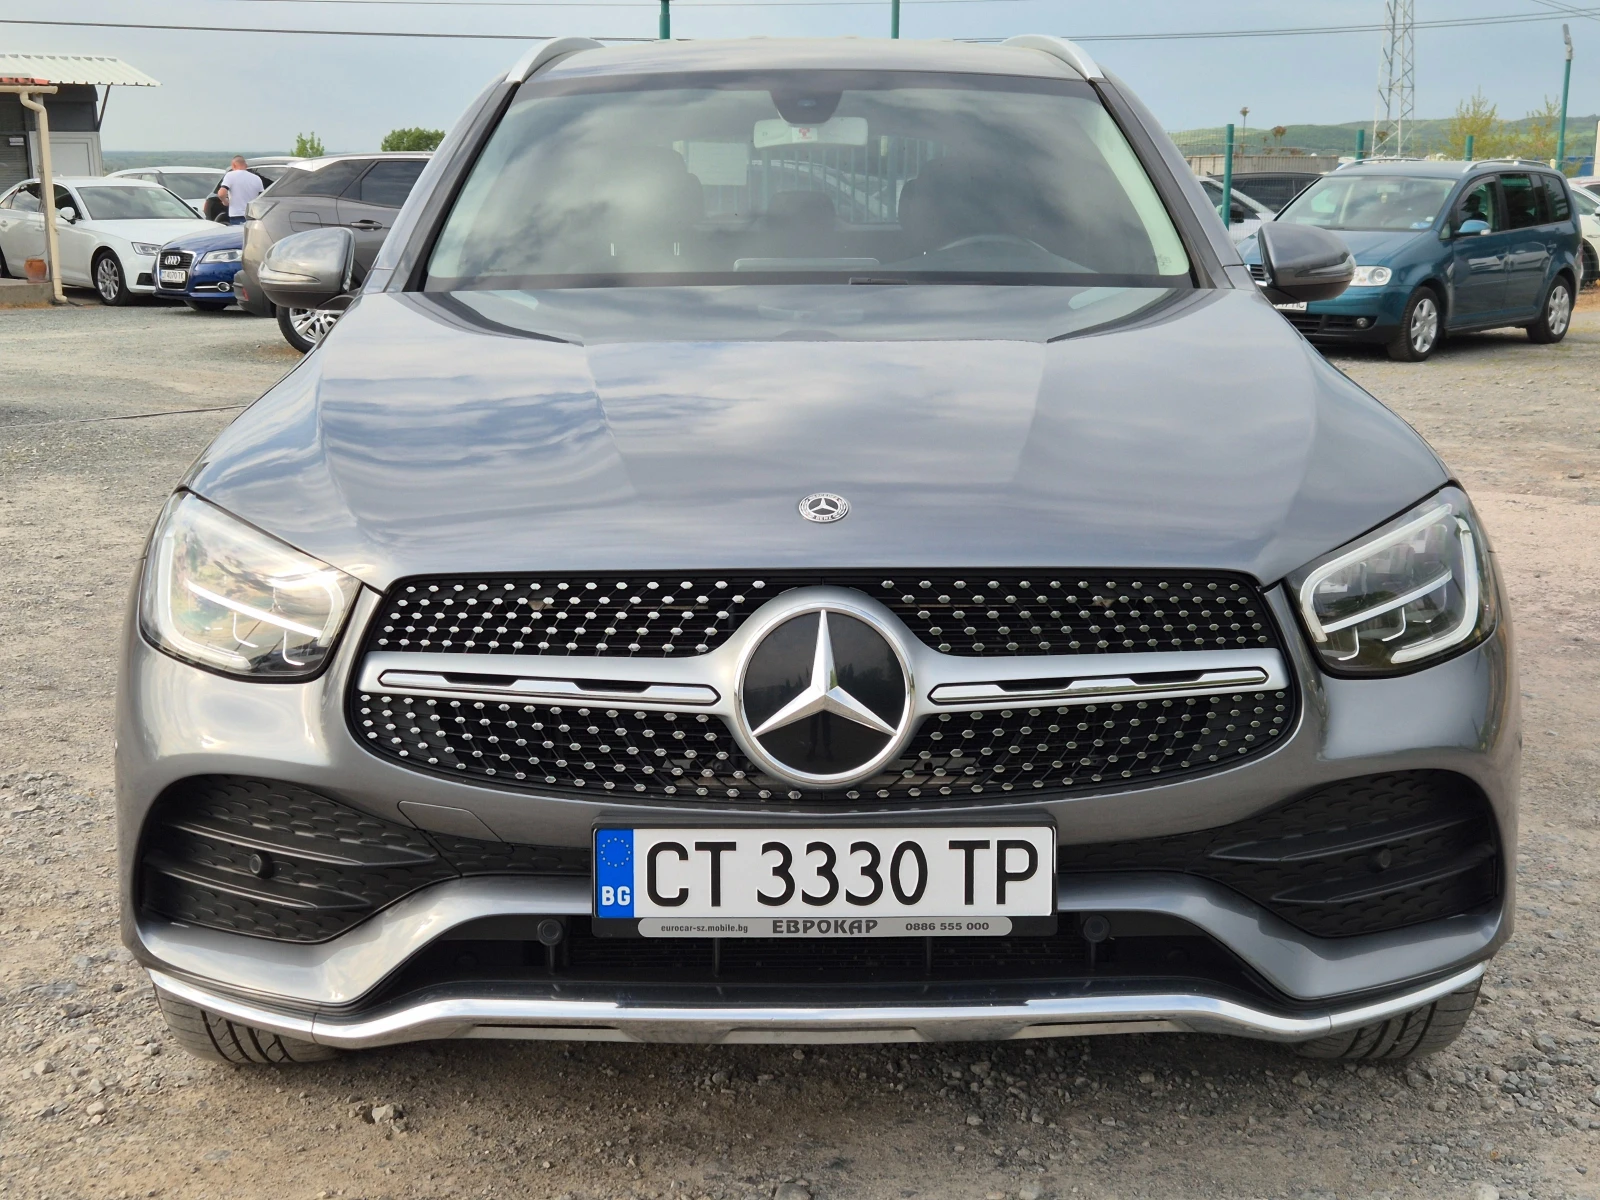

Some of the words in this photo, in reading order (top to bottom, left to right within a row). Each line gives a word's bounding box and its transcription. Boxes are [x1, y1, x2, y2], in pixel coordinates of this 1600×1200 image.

[646, 841, 737, 908] CT
[756, 840, 929, 907] 3330
[948, 839, 1039, 906] TP
[601, 885, 631, 906] BG
[660, 923, 748, 934] eurocar-sz.mobile.bg
[772, 919, 879, 935] ЕВРОКАР
[905, 922, 936, 931] 0886
[939, 922, 963, 931] 555
[966, 922, 990, 931] 000
